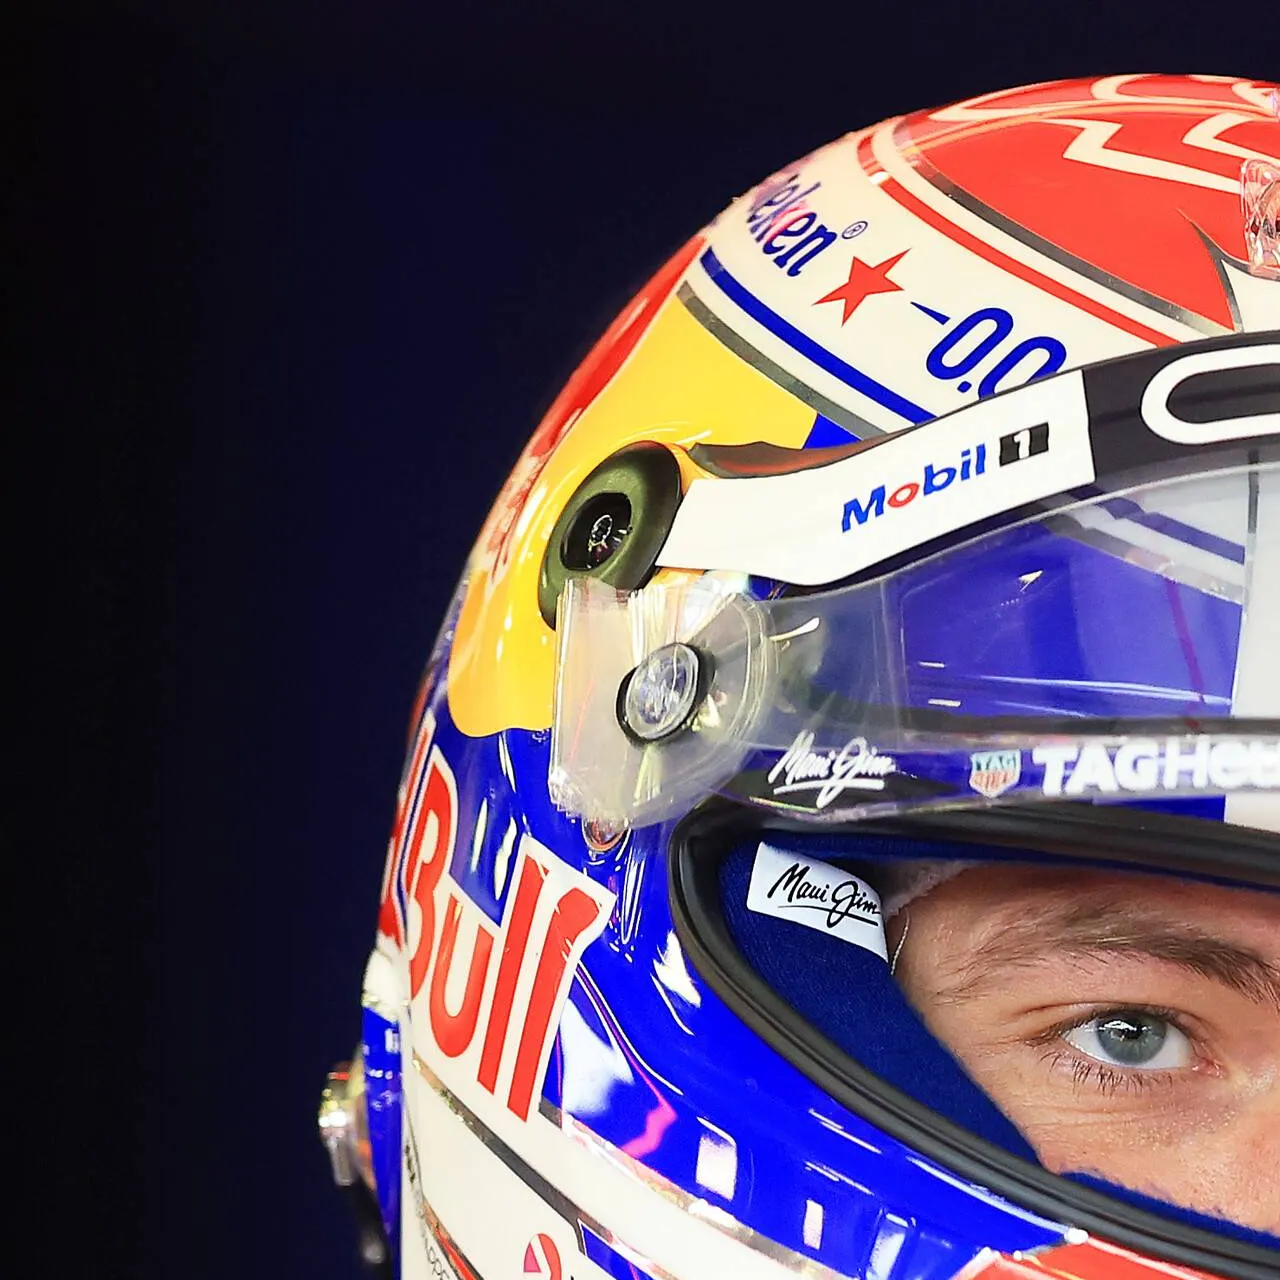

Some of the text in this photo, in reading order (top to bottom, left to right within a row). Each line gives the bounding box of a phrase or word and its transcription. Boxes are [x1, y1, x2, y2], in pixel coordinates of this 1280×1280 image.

[842, 443, 987, 533] Mobil
[767, 862, 882, 929] Maui Jim
[402, 760, 602, 1123] Bull
